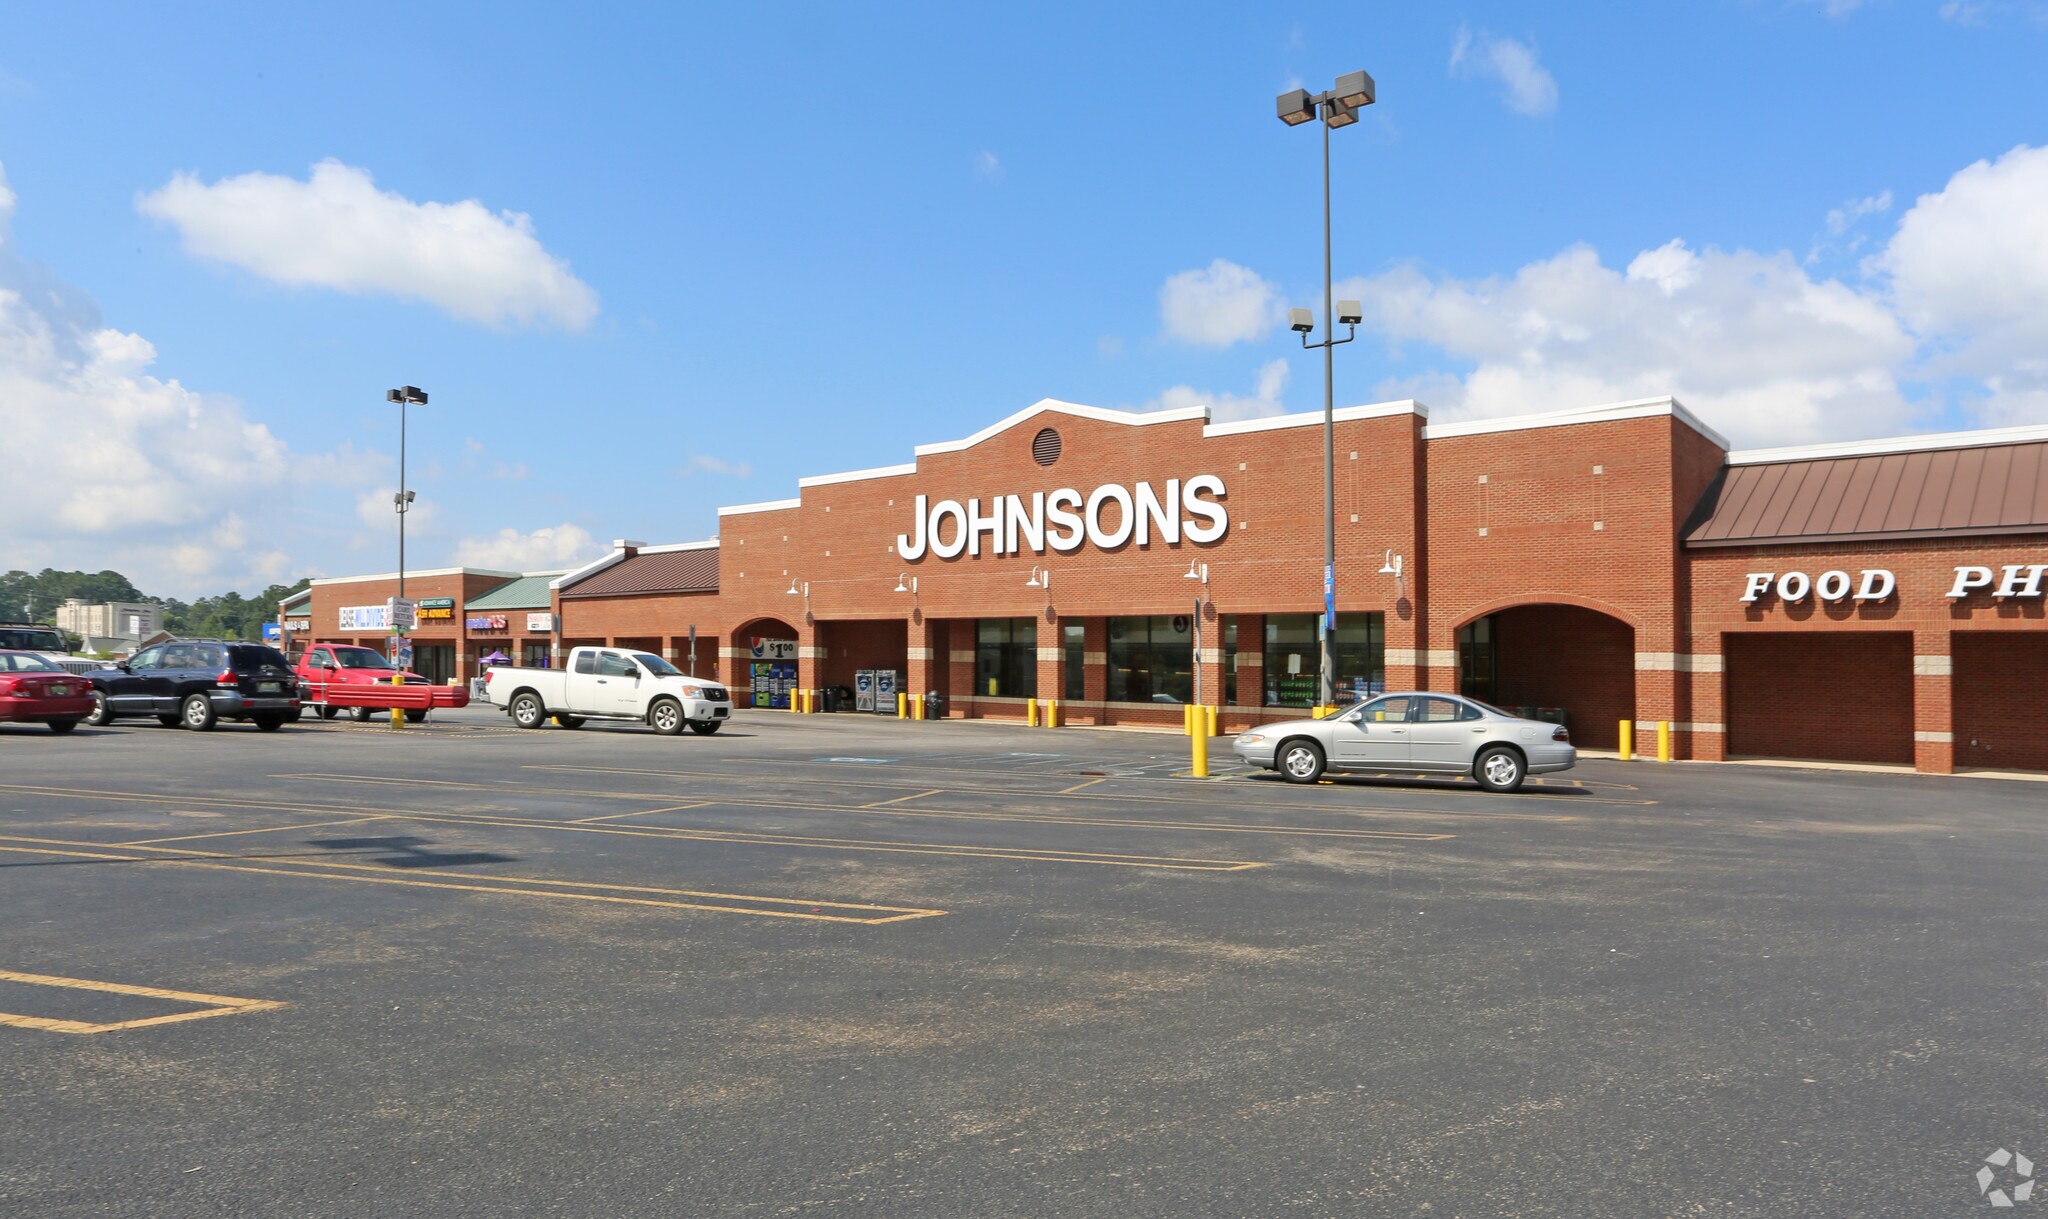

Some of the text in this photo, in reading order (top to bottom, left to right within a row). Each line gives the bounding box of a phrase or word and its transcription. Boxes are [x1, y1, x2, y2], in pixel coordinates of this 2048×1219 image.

[897, 474, 1228, 560] JOHNSONS
[1739, 569, 1896, 602] FOOD
[1945, 564, 2048, 597] PH
[429, 608, 451, 618] ADVANCE
